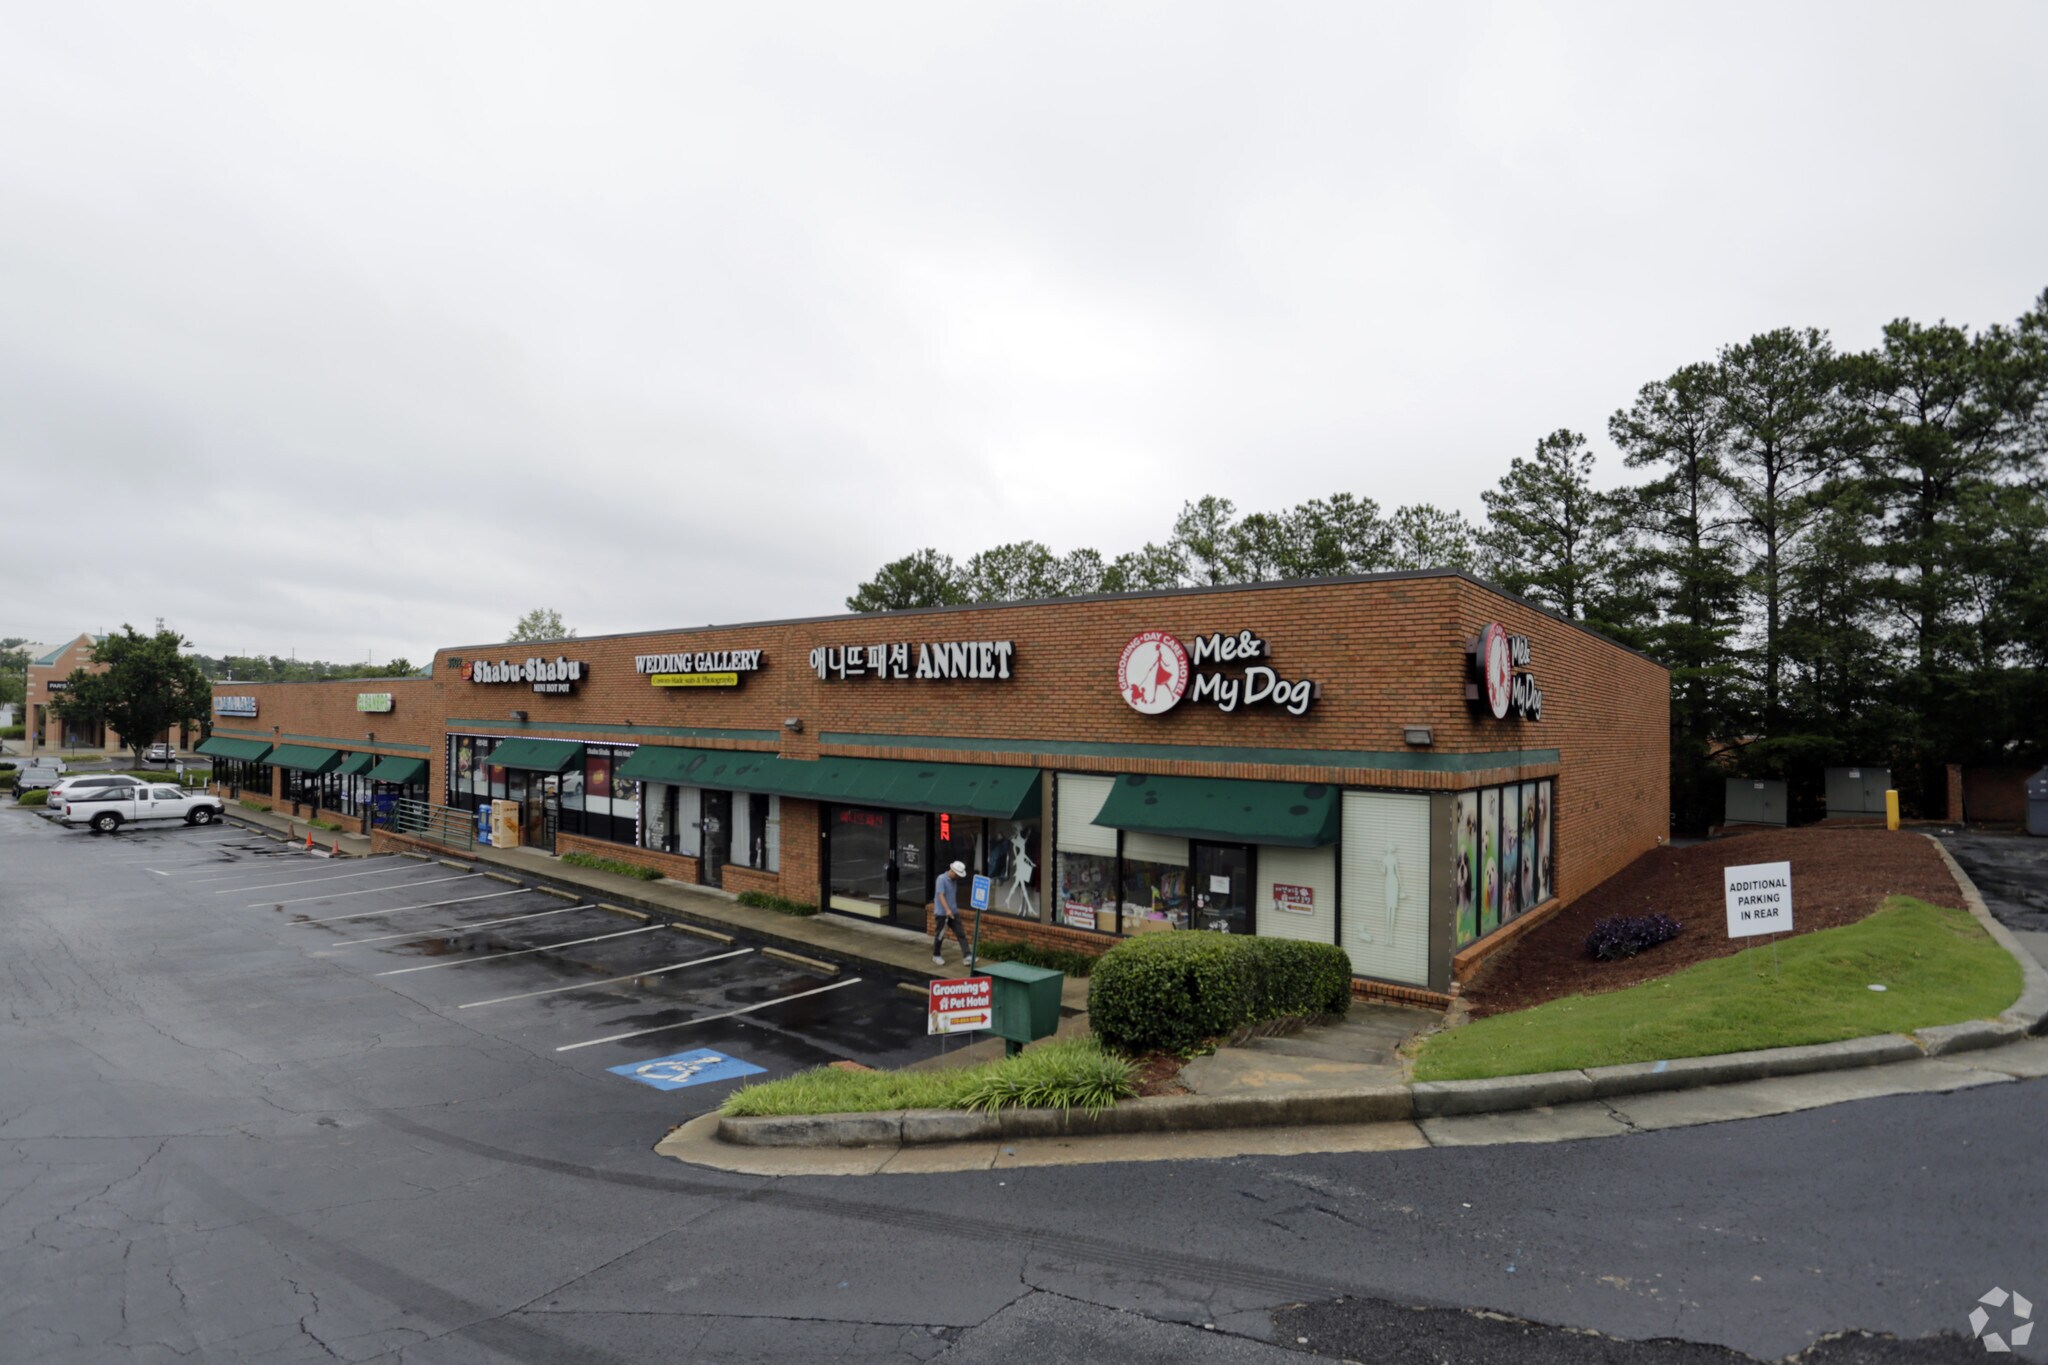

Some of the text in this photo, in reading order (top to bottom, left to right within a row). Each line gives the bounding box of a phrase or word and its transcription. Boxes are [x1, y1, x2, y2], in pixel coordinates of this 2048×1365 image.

[635, 650, 761, 674] WEDDING GALLERY
[915, 641, 1013, 679] ANNIET
[1118, 631, 1188, 697] GROOMING DAY CARE HOTEL
[1192, 666, 1312, 715] My Dog
[1511, 673, 1541, 721] My Dog
[1729, 879, 1787, 892] ADDITIONAL
[1738, 893, 1780, 906] PARKING
[1741, 908, 1779, 920] IN REAR
[933, 981, 979, 996] Grooming
[950, 995, 989, 1009] Pet Hotel
